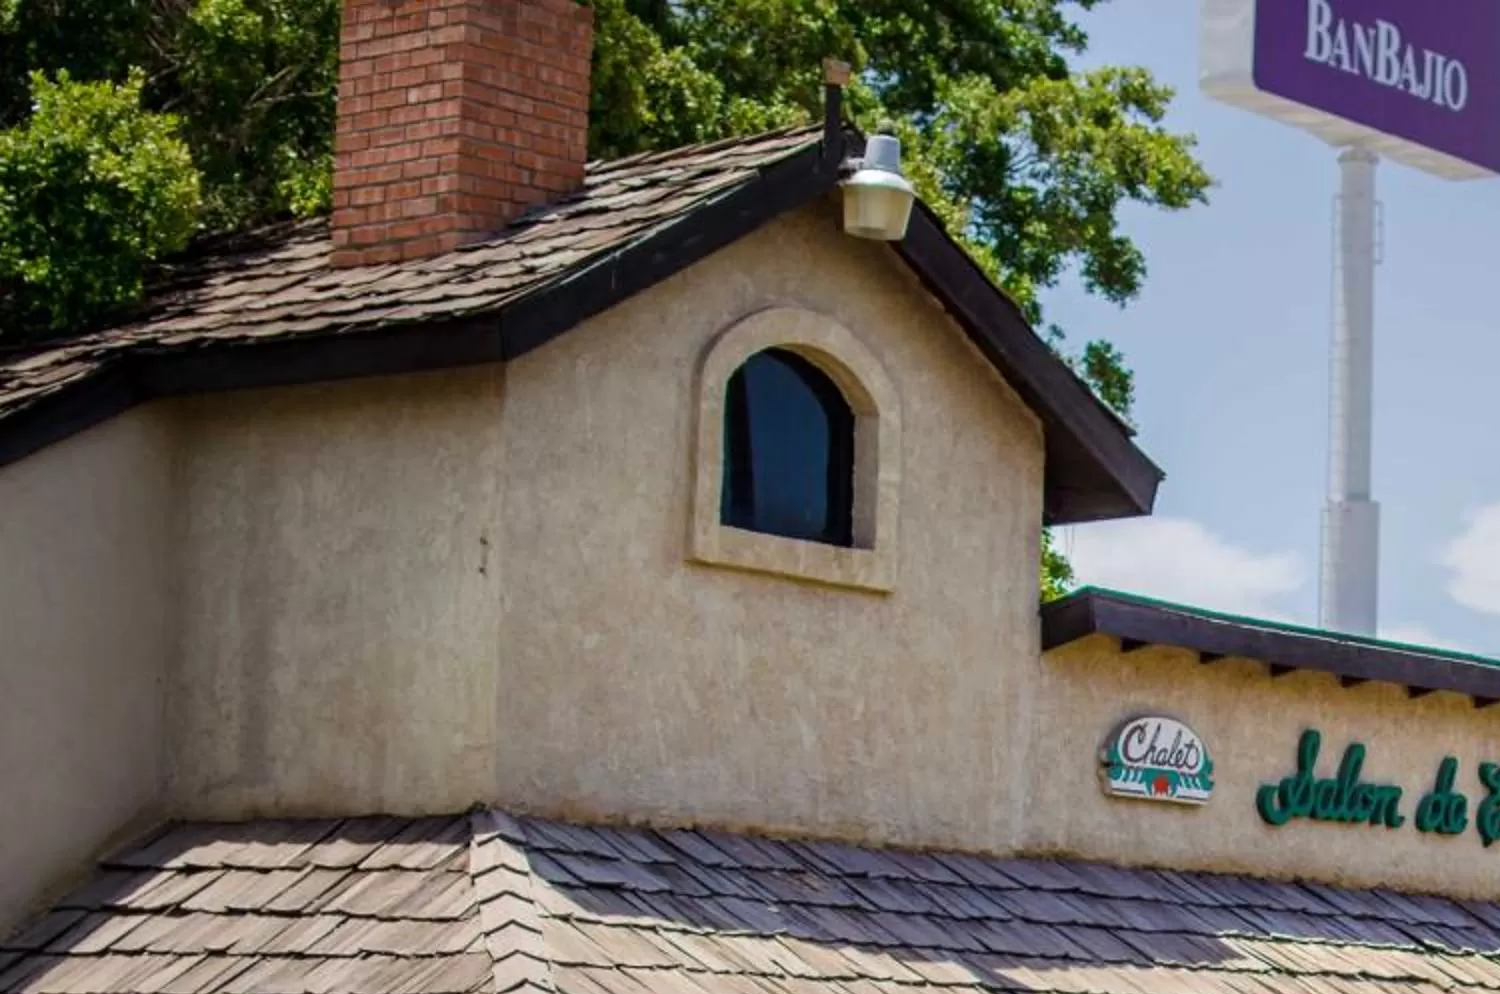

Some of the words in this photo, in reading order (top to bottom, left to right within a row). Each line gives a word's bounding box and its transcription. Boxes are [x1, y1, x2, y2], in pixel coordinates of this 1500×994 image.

[1122, 721, 1201, 771] Chalet
[1256, 729, 1404, 827] Salon
[1415, 756, 1468, 835] de
